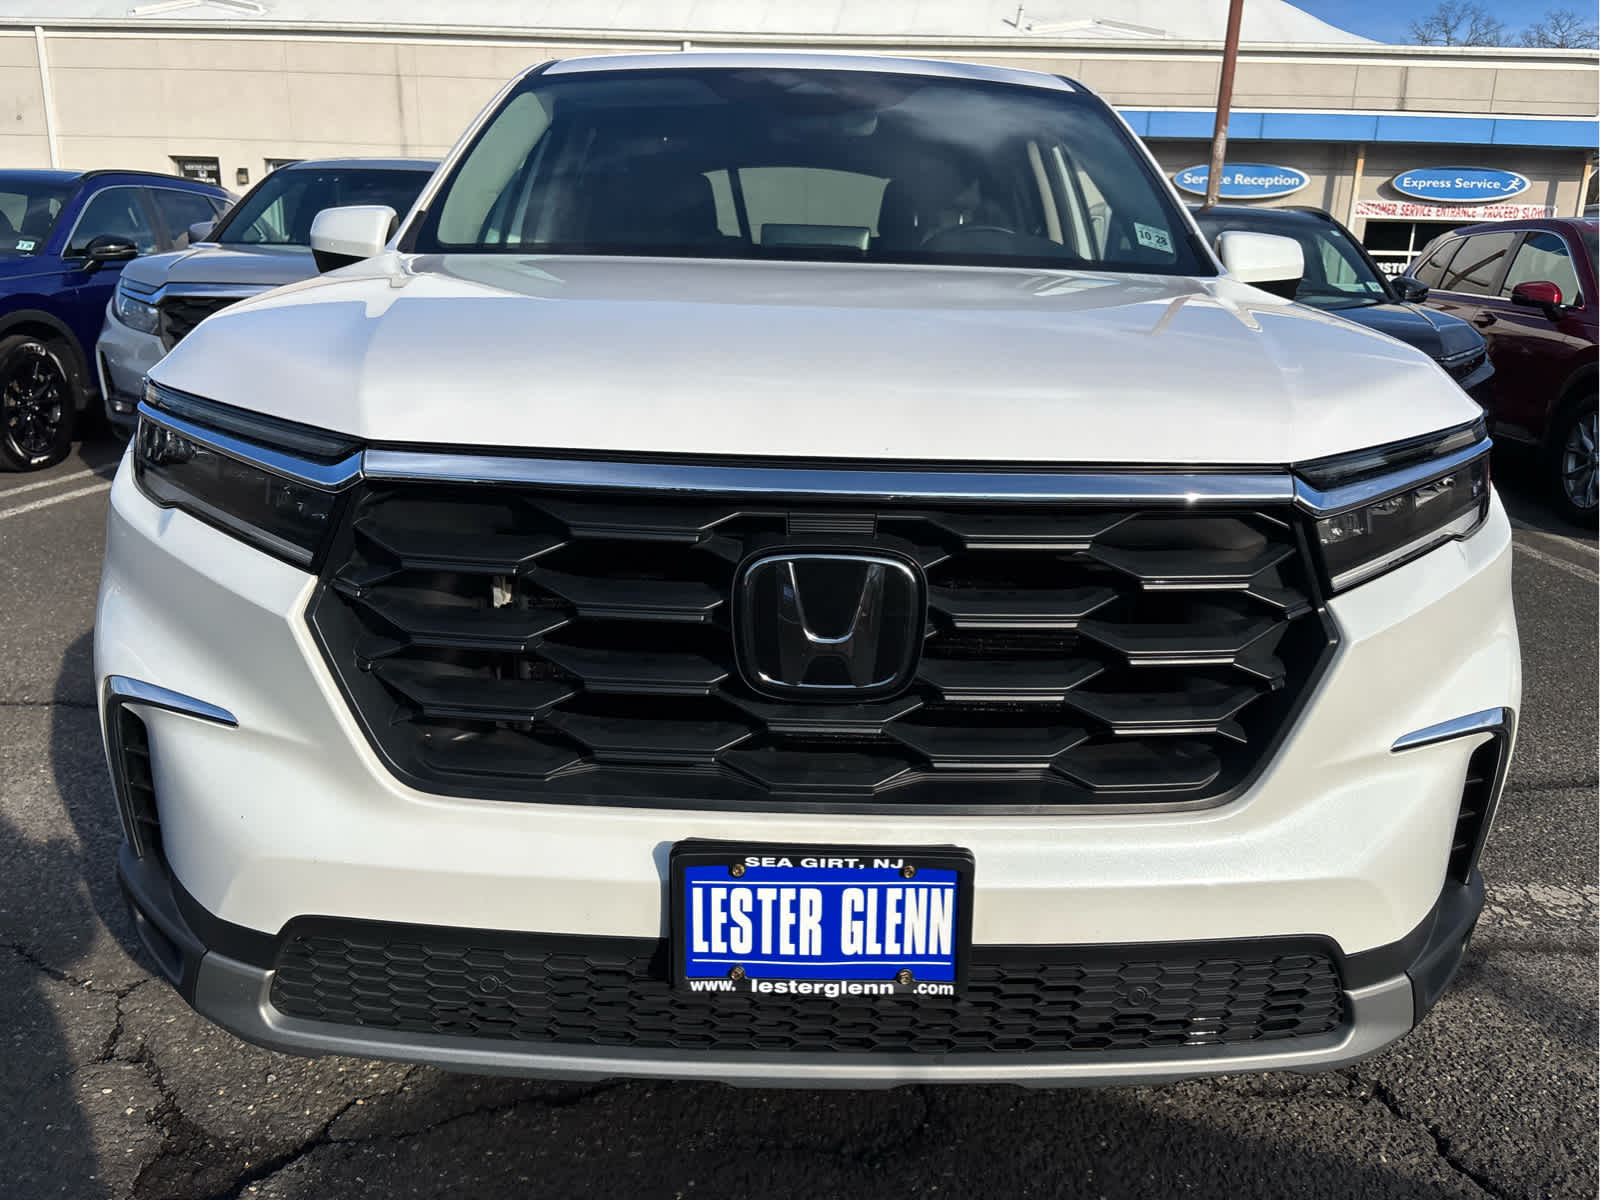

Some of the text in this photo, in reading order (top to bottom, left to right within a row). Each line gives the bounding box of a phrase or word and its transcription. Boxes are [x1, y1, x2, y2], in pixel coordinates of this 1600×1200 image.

[1183, 172, 1300, 188] Serce Reception
[1402, 177, 1501, 190] Express Service
[1355, 202, 1397, 216] CUSTOMER
[1400, 203, 1432, 217] SERVICE
[1435, 205, 1477, 218] ENTRANCE
[1482, 206, 1519, 219] PROCEED
[744, 857, 904, 870] SEA GIRT, NJ
[692, 887, 954, 956] LESTER GLENN
[690, 979, 954, 998] www. lesterglenn .com
